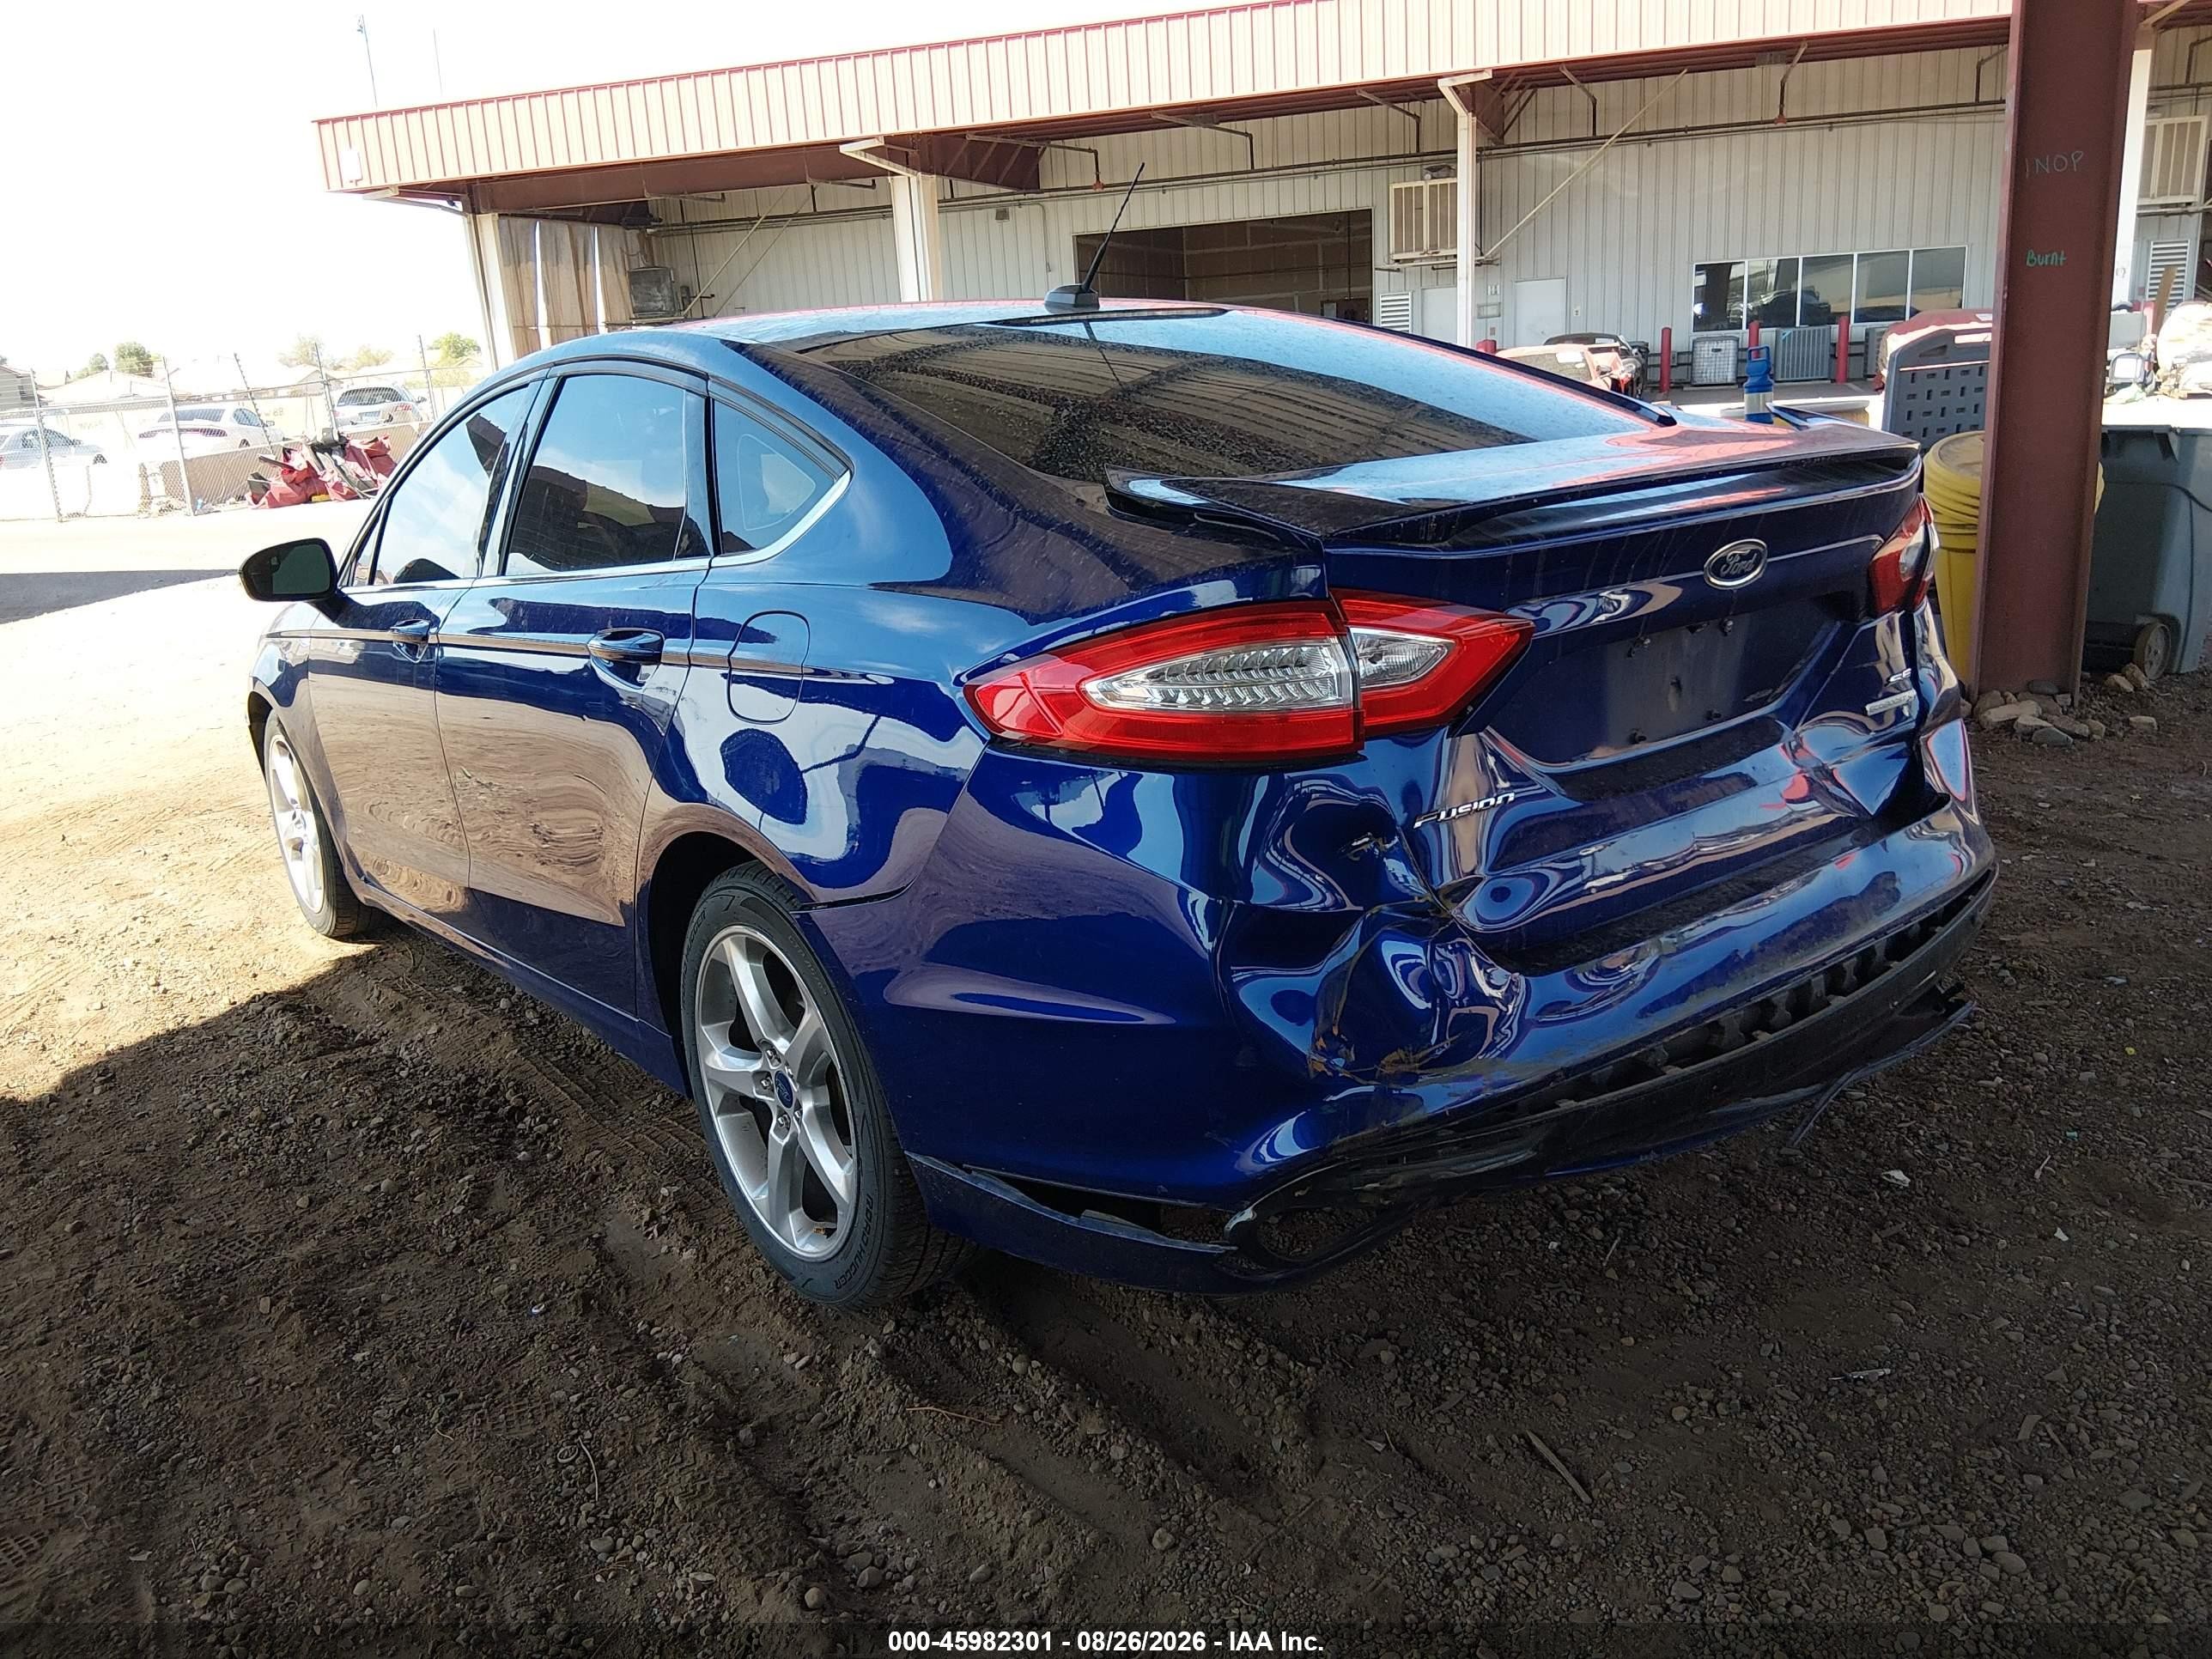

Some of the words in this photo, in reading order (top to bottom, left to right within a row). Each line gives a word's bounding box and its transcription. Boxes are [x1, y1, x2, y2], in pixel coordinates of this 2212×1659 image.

[2024, 150, 2084, 178] INOP
[2025, 249, 2068, 267] Burnt
[1720, 549, 1758, 577] Ford
[860, 1194, 873, 1247] ROAD
